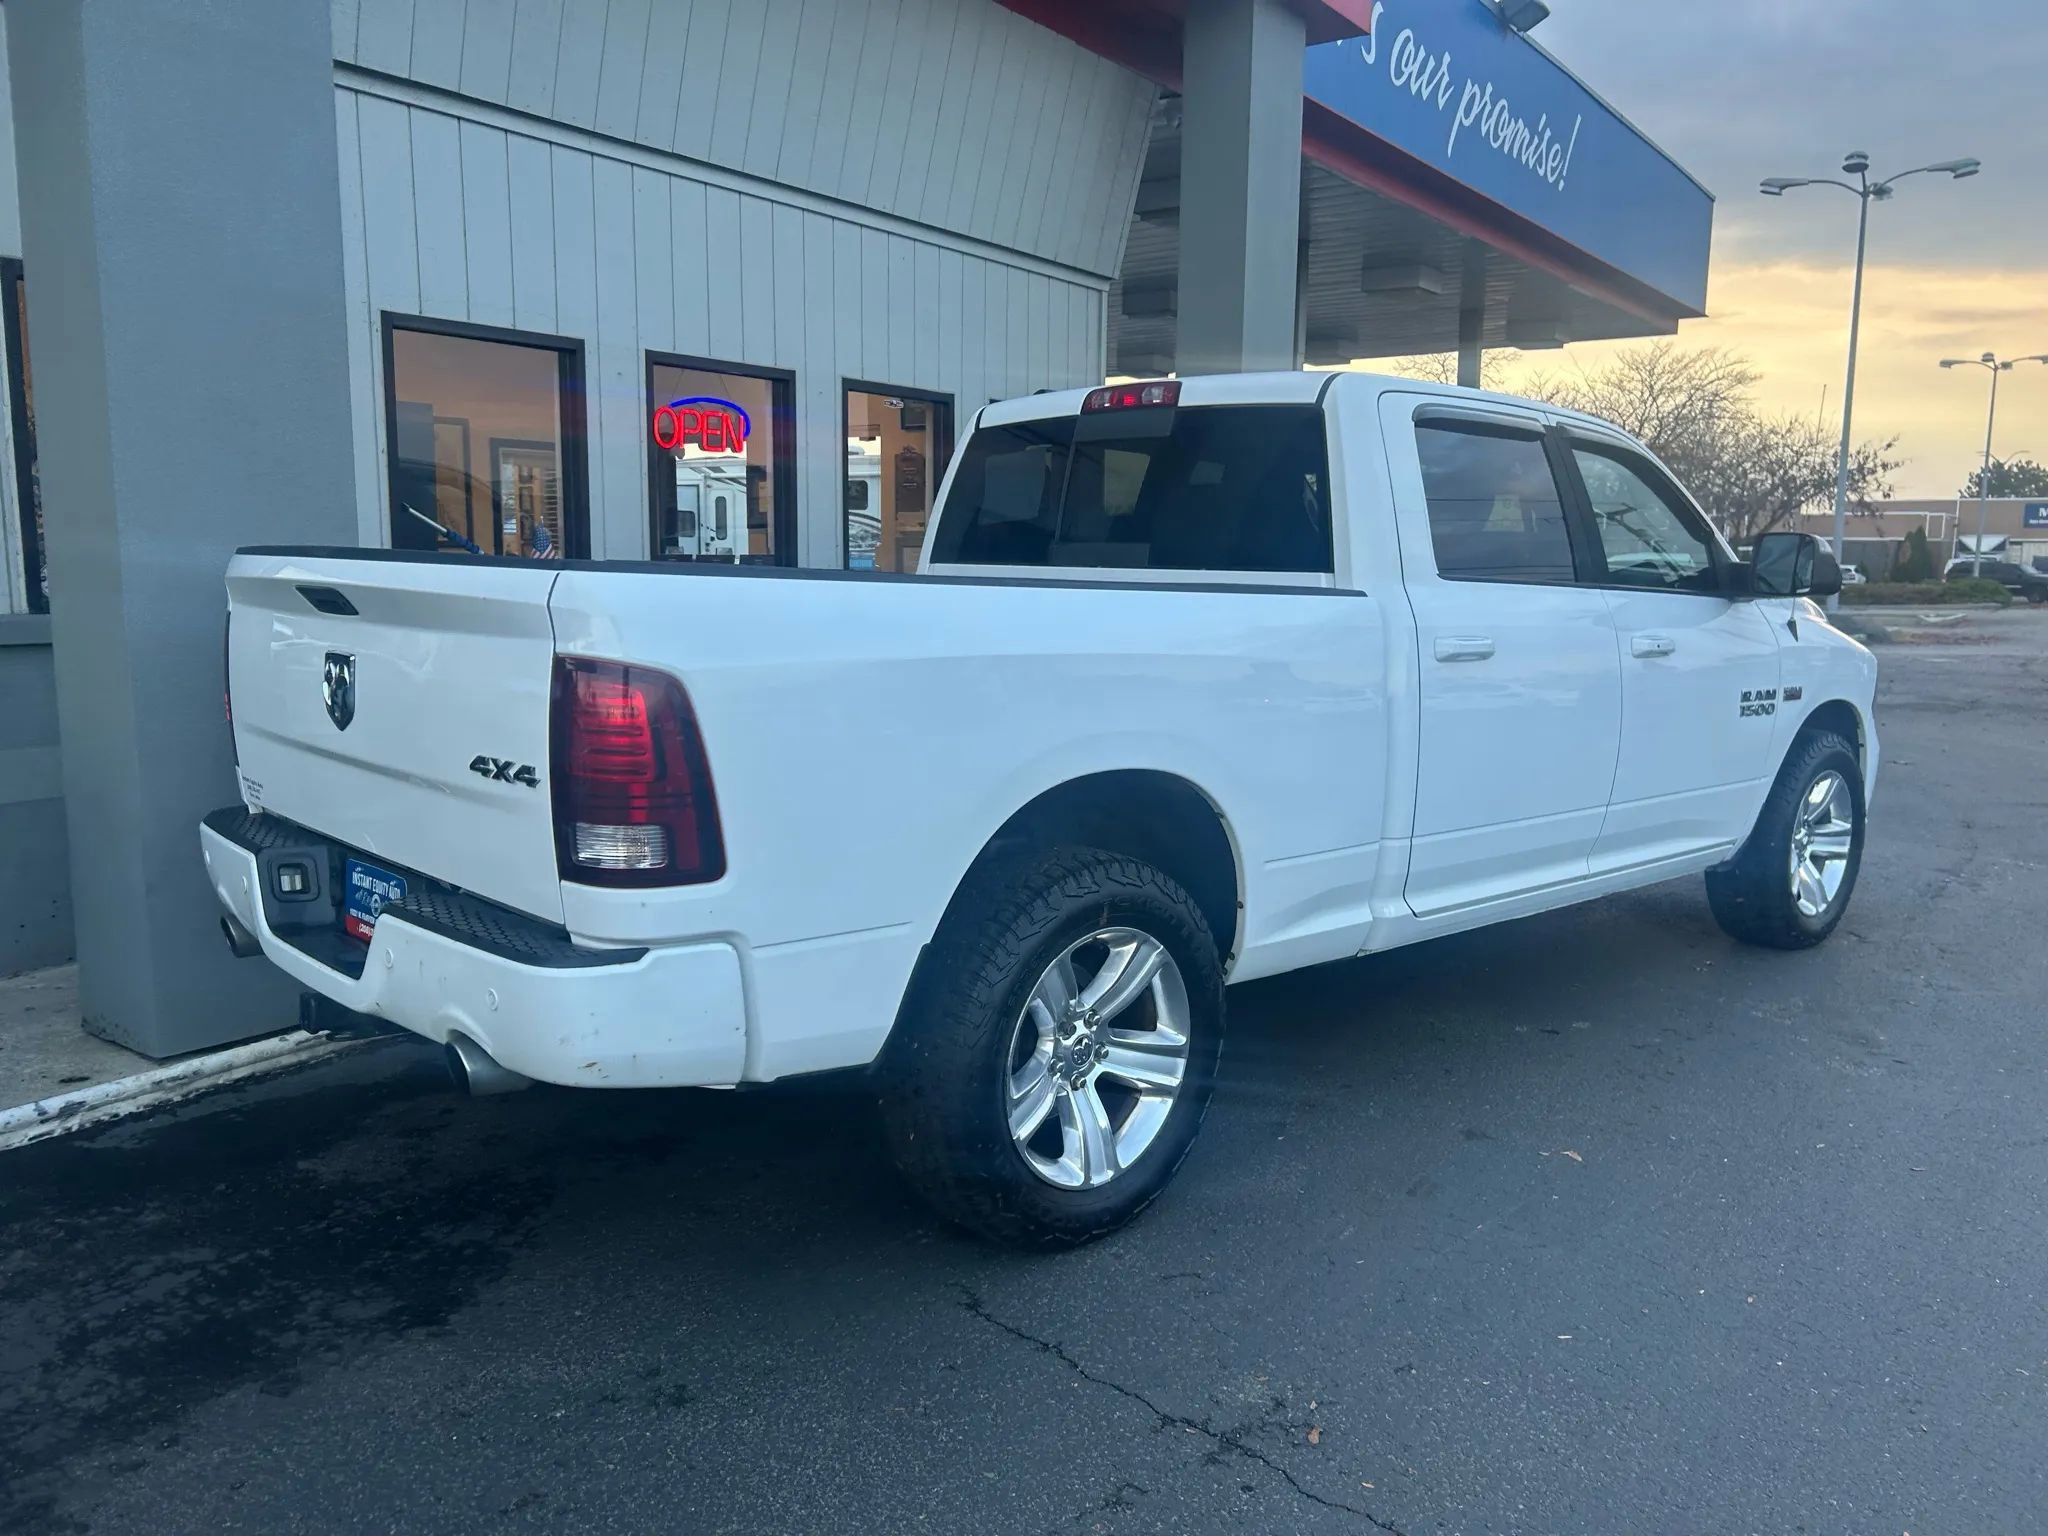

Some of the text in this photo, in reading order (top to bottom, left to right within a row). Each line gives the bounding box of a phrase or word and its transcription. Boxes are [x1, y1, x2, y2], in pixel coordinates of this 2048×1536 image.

[1390, 28, 1455, 110] our
[1447, 78, 1582, 191] promise!
[653, 405, 745, 453] OPEN
[1740, 688, 1777, 703] RAM
[1739, 703, 1776, 718] 1500
[352, 871, 373, 891] INSTANT
